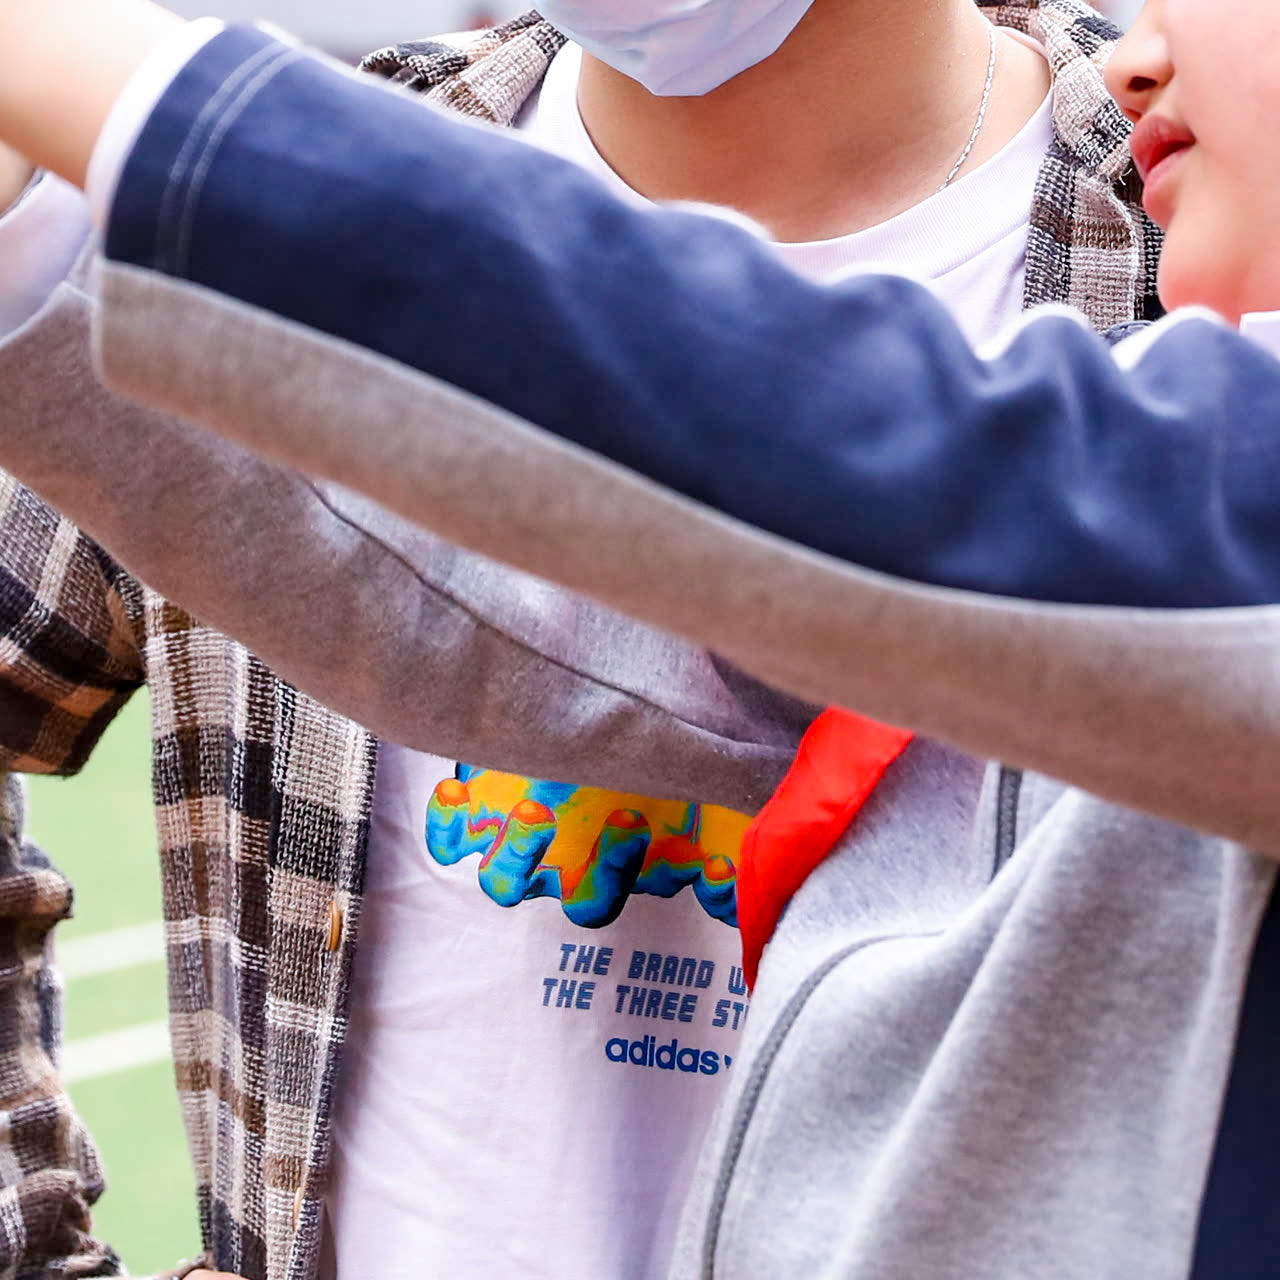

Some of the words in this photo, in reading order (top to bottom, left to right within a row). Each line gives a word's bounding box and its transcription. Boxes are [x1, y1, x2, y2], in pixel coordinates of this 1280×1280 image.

[558, 943, 613, 976] THE
[627, 950, 715, 989] BRAND
[542, 978, 596, 1010] THE
[615, 985, 698, 1023] THREE
[712, 999, 749, 1030] ST
[605, 1034, 720, 1076] adidas
